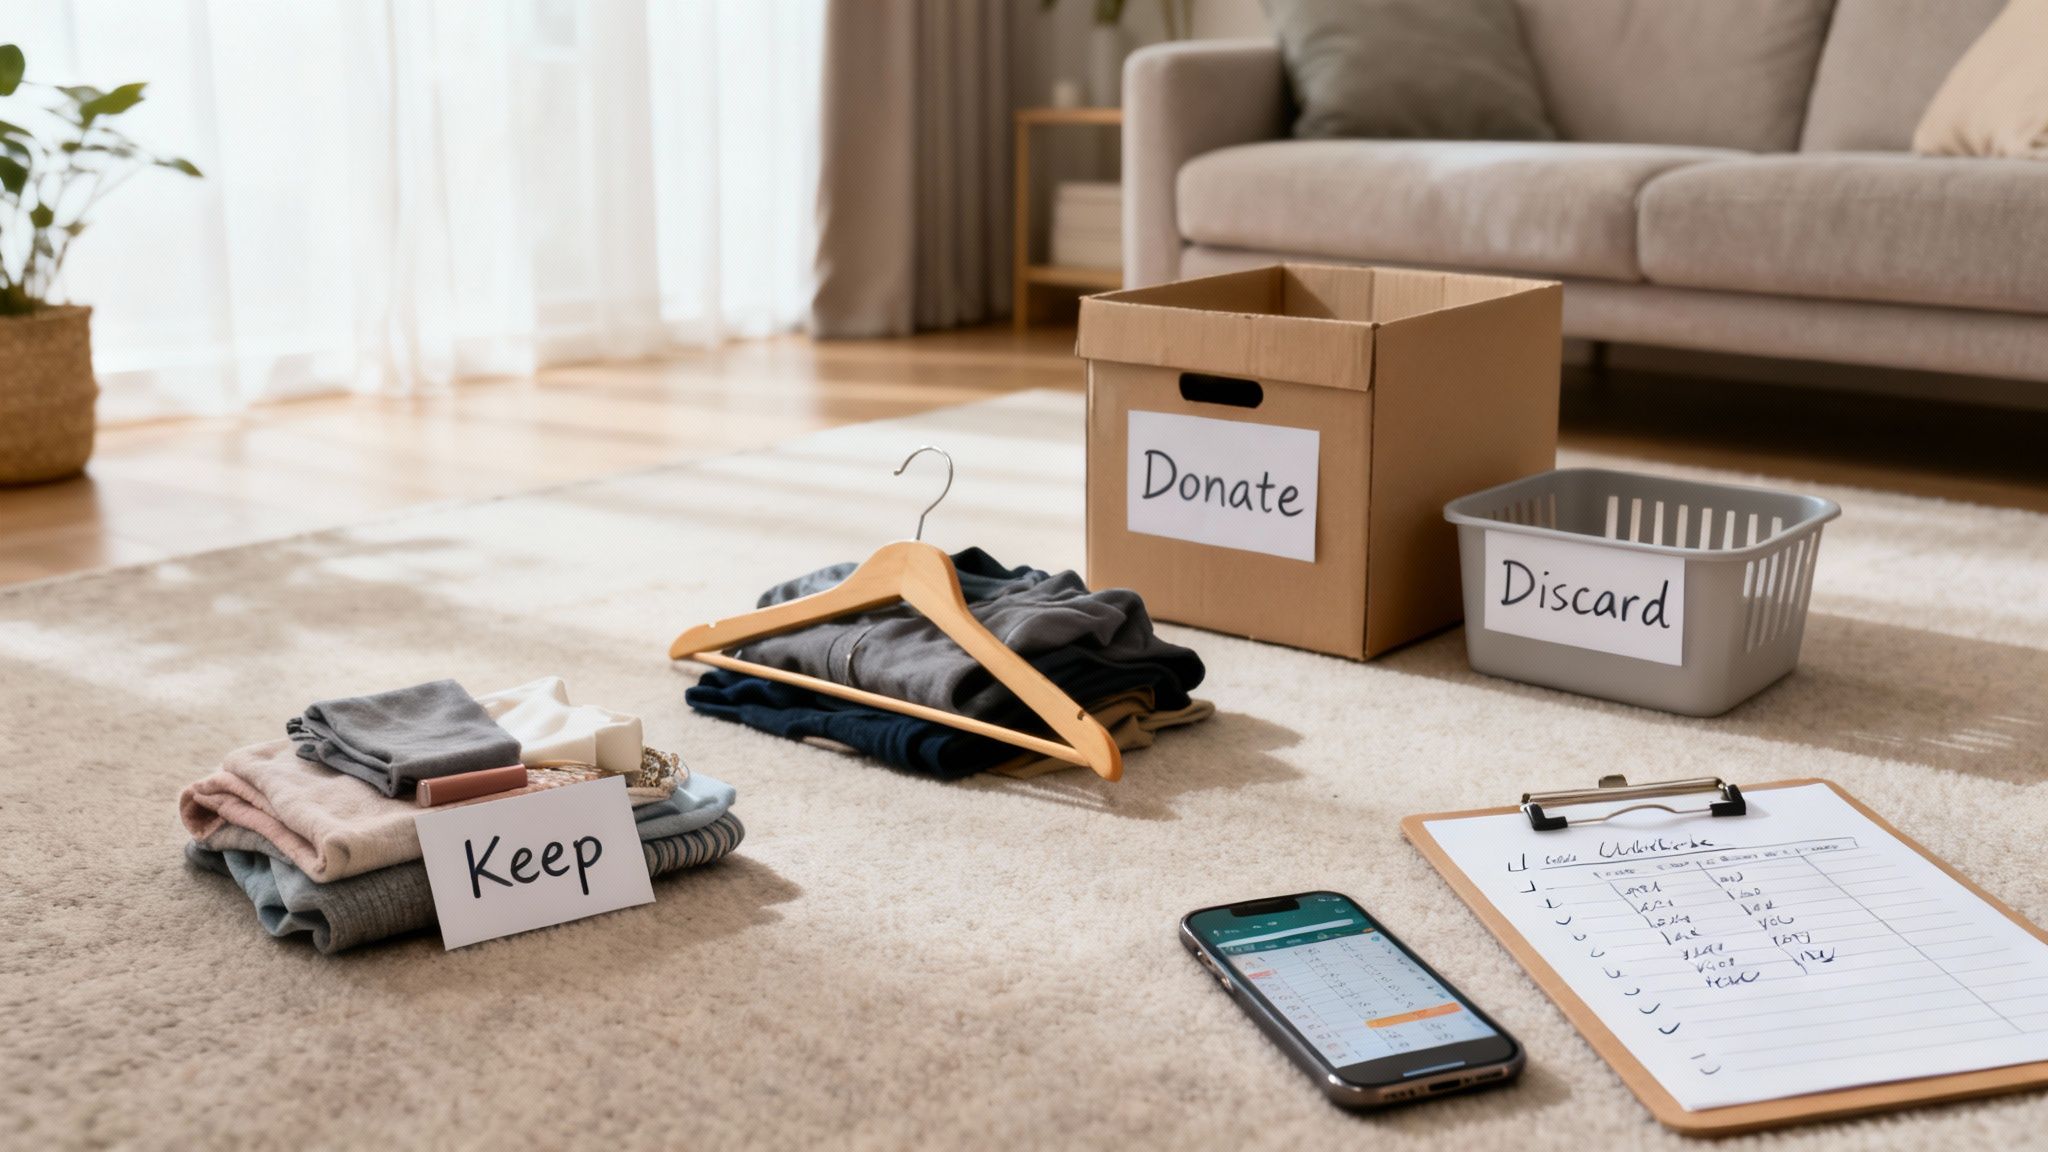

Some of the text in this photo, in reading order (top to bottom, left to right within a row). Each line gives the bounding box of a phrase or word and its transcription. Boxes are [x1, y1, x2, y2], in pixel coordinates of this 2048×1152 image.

[1142, 449, 1304, 517] Donate
[1501, 559, 1670, 629] Discard
[464, 835, 603, 899] Keep
